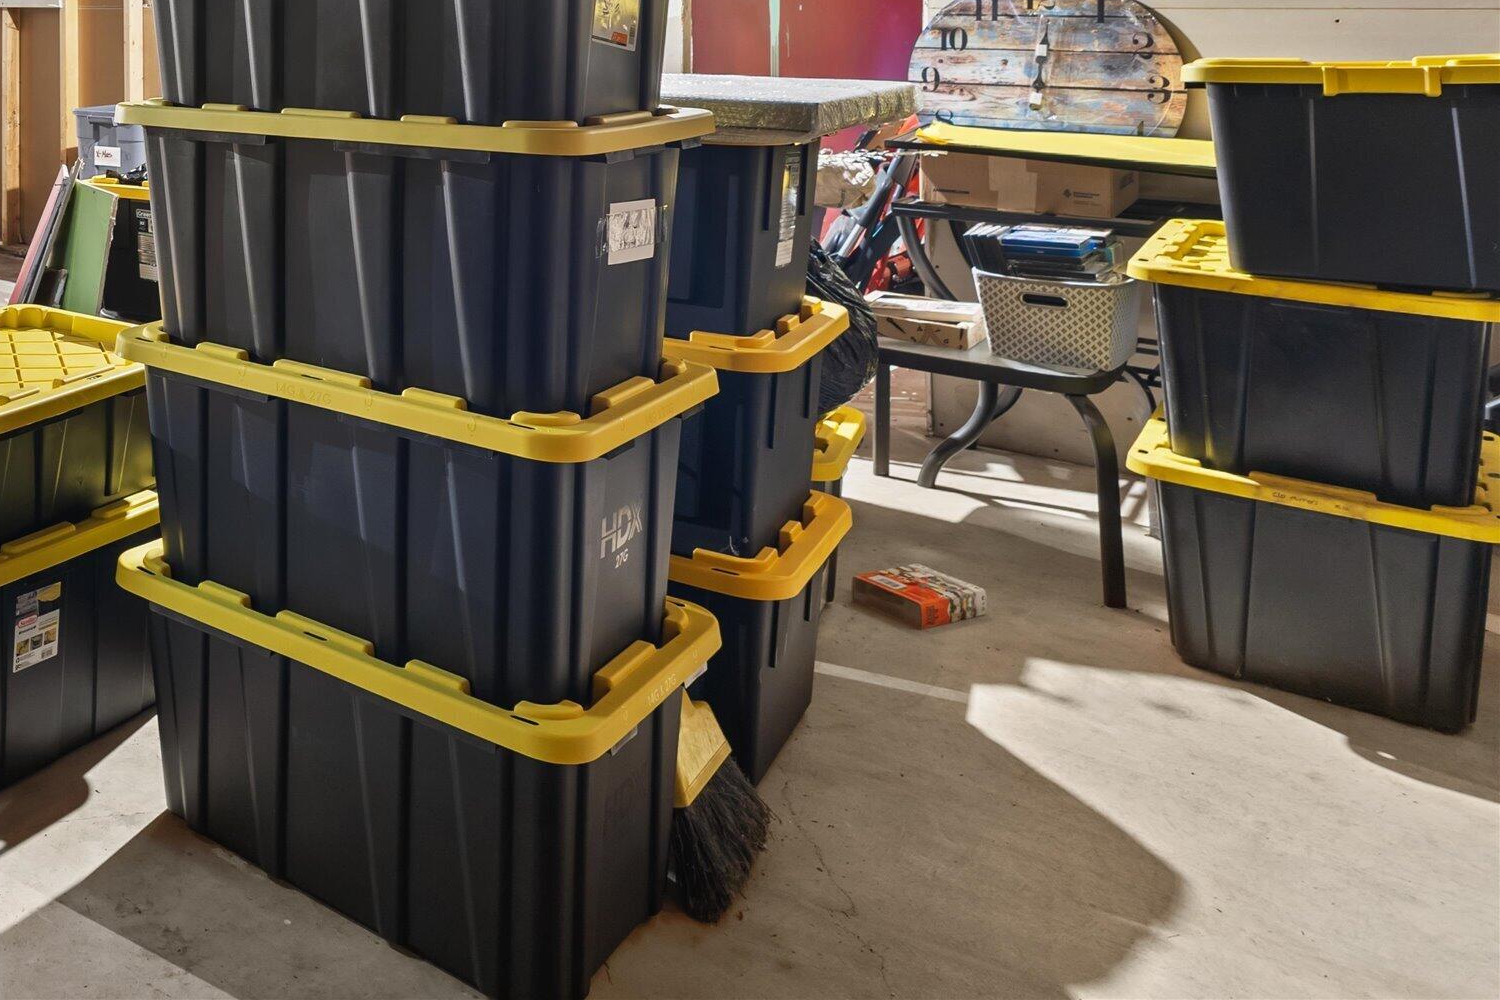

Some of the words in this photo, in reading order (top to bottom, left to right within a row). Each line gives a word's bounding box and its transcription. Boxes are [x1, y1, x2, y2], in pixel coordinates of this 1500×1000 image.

[940, 27, 968, 52] 10
[1132, 31, 1154, 60] 2
[921, 66, 941, 92] 9
[1147, 75, 1172, 105] 3
[600, 503, 643, 560] HDX
